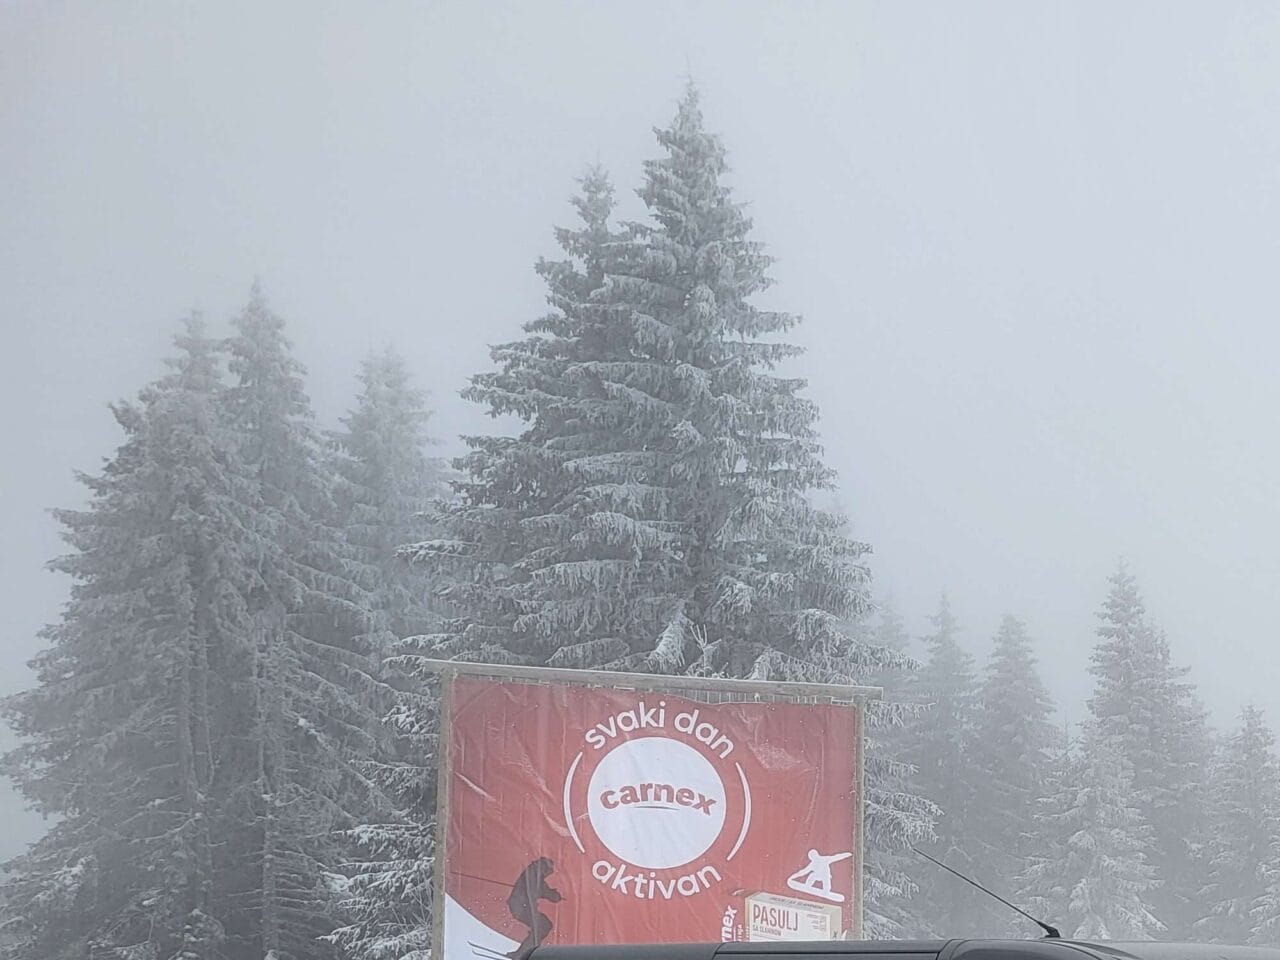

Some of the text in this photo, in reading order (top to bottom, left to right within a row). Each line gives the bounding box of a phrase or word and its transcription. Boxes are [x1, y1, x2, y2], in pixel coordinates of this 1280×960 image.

[585, 701, 734, 759] svaki dan
[600, 782, 717, 816] carnex
[592, 860, 722, 899] aktivan
[721, 905, 738, 942] rnex
[753, 904, 798, 931] PASULJ
